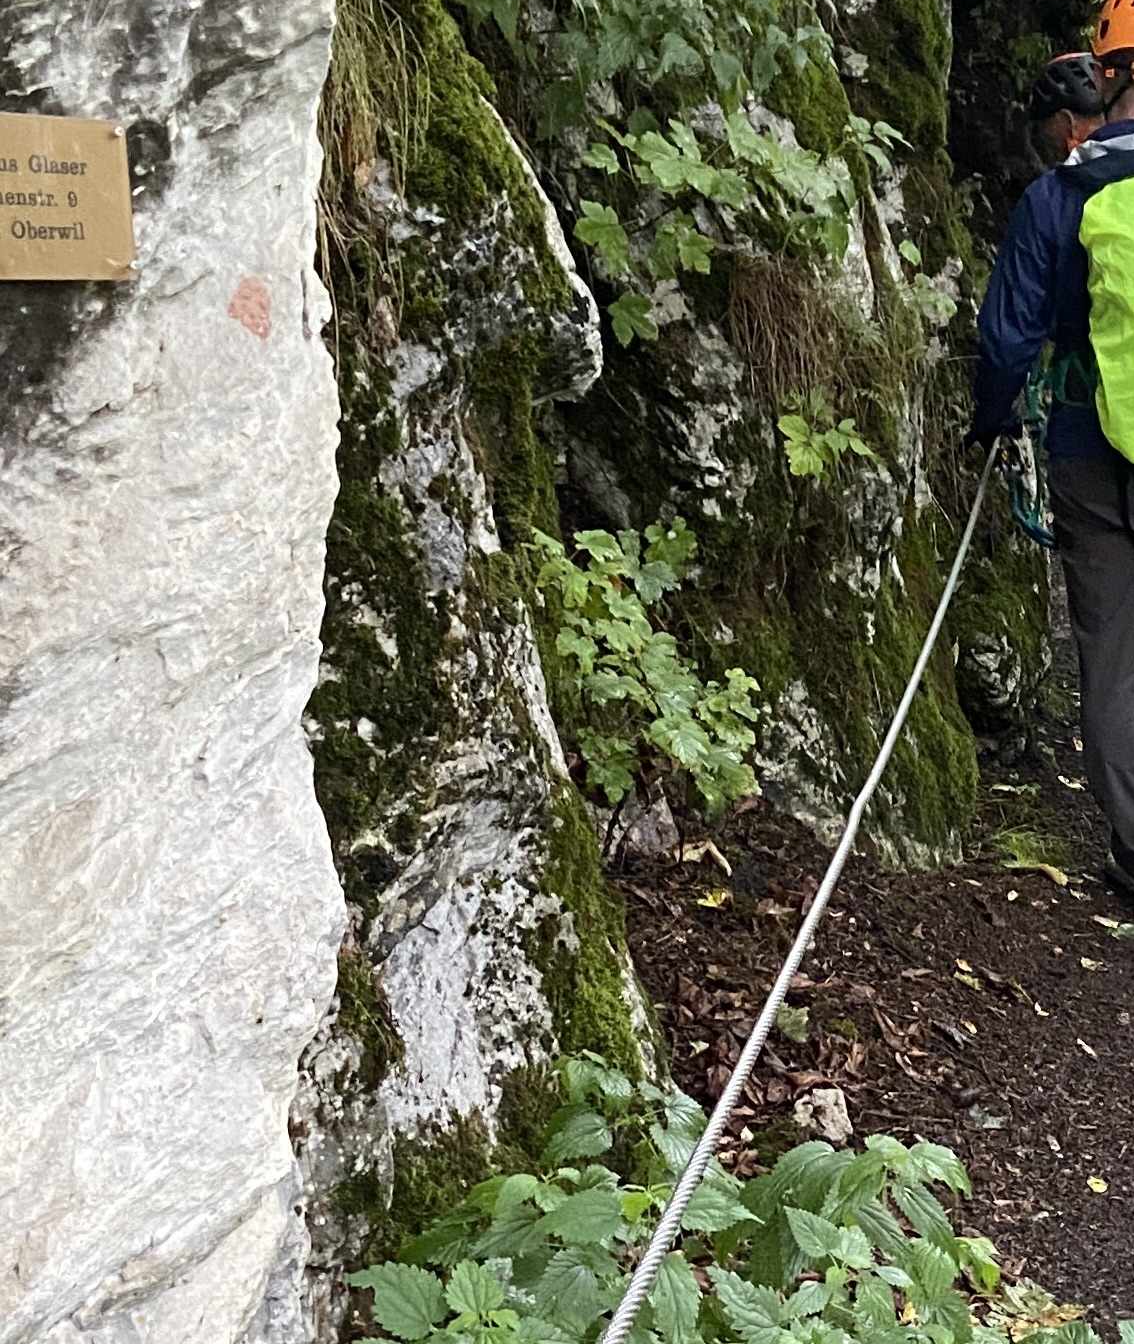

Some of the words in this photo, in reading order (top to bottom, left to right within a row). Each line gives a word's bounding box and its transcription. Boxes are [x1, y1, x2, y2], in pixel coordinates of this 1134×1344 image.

[28, 154, 88, 176] Glaser
[67, 190, 78, 208] 9
[11, 219, 85, 240] Oberwil
